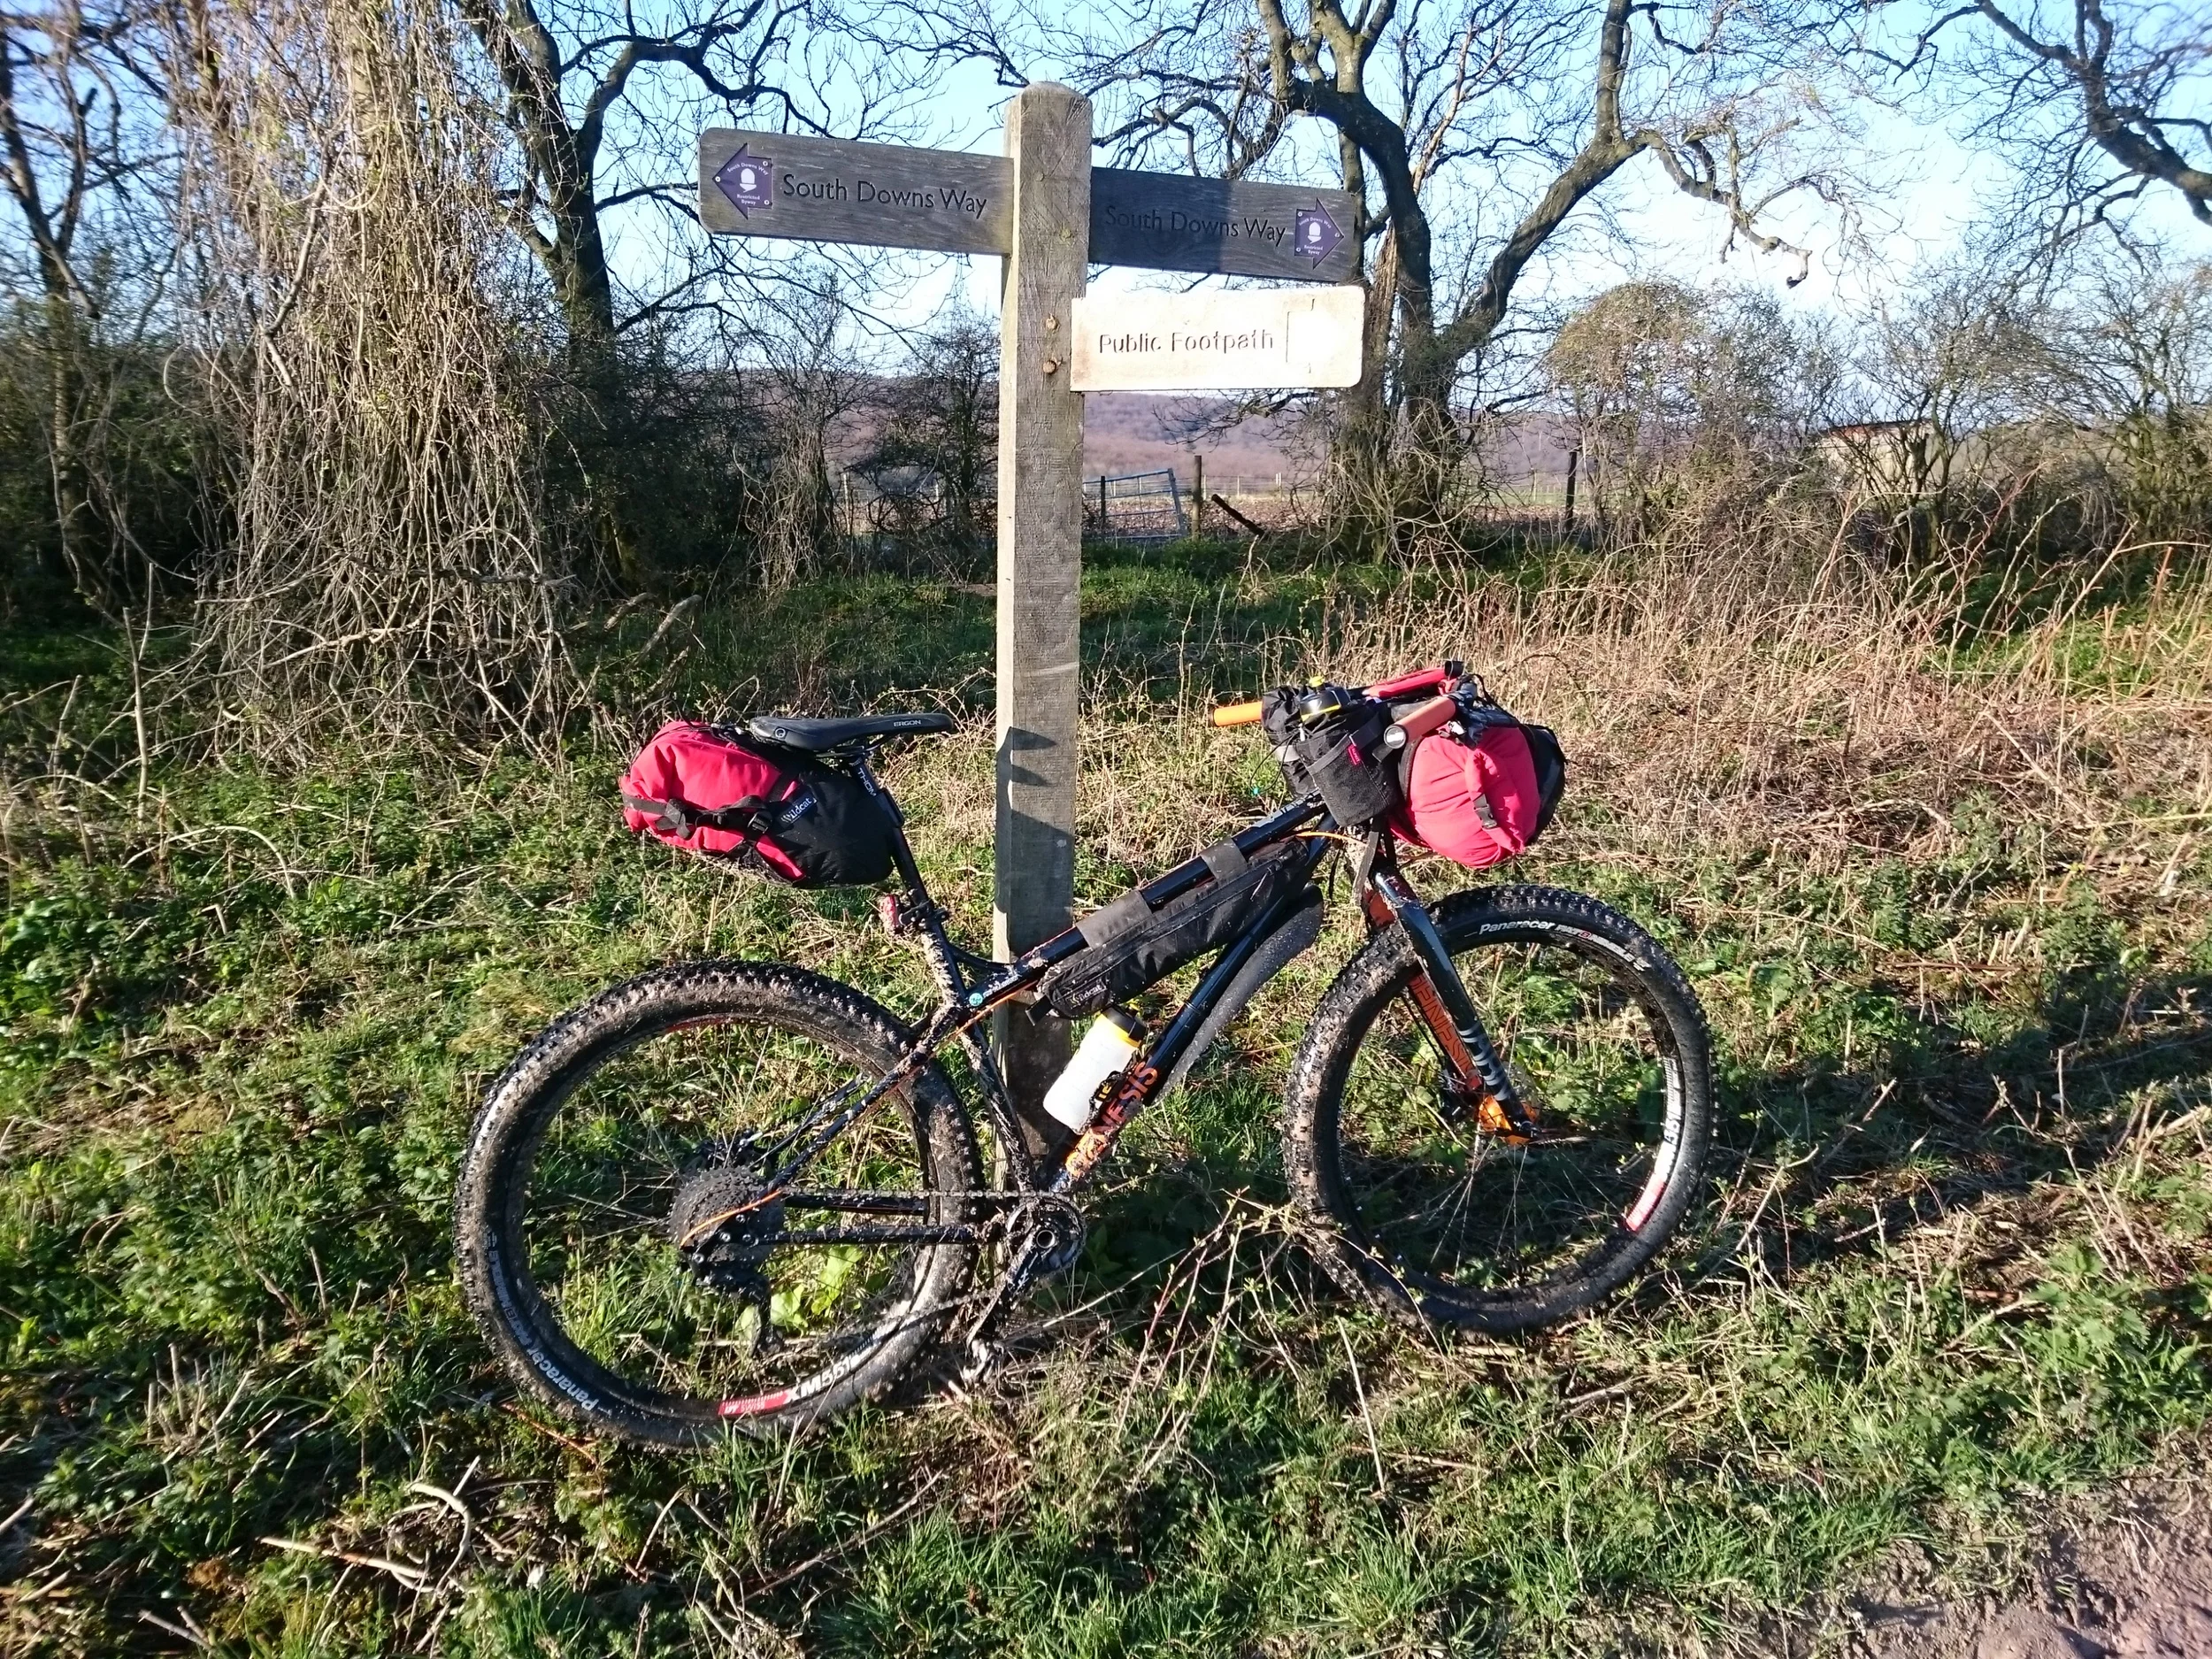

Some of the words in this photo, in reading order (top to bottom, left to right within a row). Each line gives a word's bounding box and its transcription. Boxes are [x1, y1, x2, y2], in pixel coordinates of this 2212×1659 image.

[783, 173, 847, 202] South
[857, 180, 934, 209] Downs
[940, 188, 987, 219] Way
[1105, 205, 1163, 232] South
[1171, 211, 1240, 238] Downs
[1243, 218, 1286, 247] Way
[1099, 333, 1161, 354] Public
[1171, 329, 1273, 355] Footpath
[780, 797, 812, 823] Wildcat
[1479, 919, 1555, 935] Panaracer
[526, 1347, 600, 1412] Panaracer
